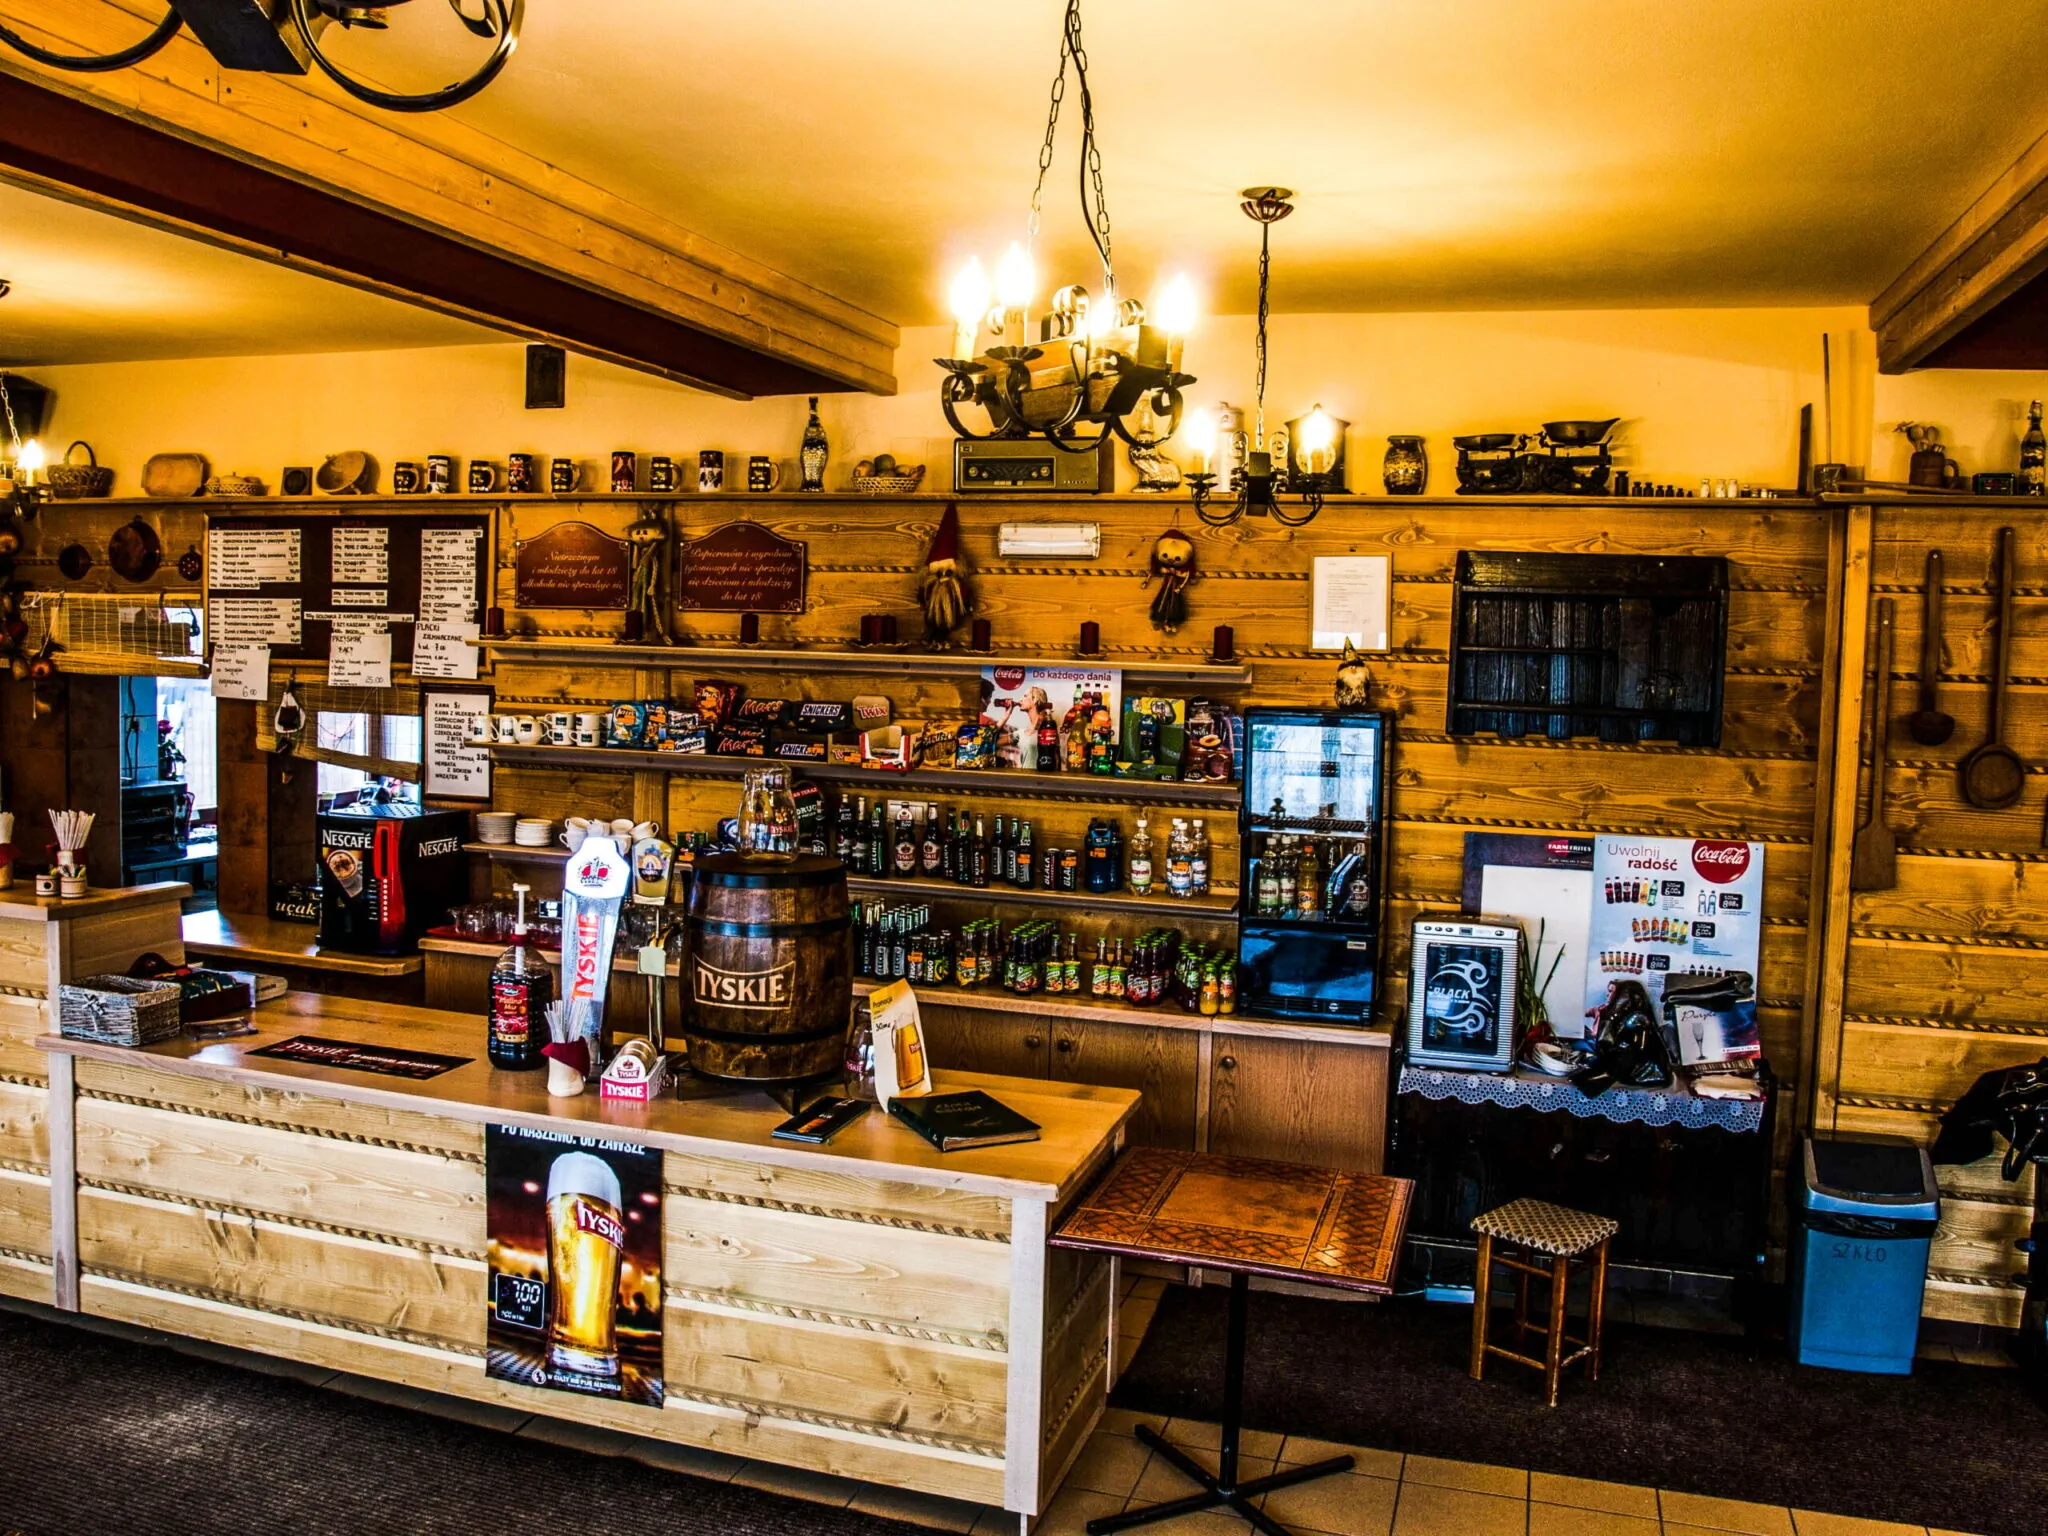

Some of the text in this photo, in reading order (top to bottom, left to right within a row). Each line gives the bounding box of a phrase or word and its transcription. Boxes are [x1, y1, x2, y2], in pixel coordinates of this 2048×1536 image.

[1032, 670, 1044, 679] Do
[1046, 670, 1085, 682] każdego
[1086, 672, 1112, 682] dania
[739, 699, 783, 716] Mars
[801, 704, 840, 716] SNICKERS
[857, 705, 887, 719] Twix
[322, 829, 371, 849] NESCAFÉ
[418, 836, 457, 858] NESCAFÉ
[1608, 844, 1748, 865] Uwolnij Coca-Cola
[1628, 858, 1678, 871] radość
[571, 912, 600, 1003] TYSKIE
[697, 965, 786, 1003] TYSKIE
[1434, 986, 1471, 1000] BLACK
[606, 1082, 645, 1099] TYSKIE
